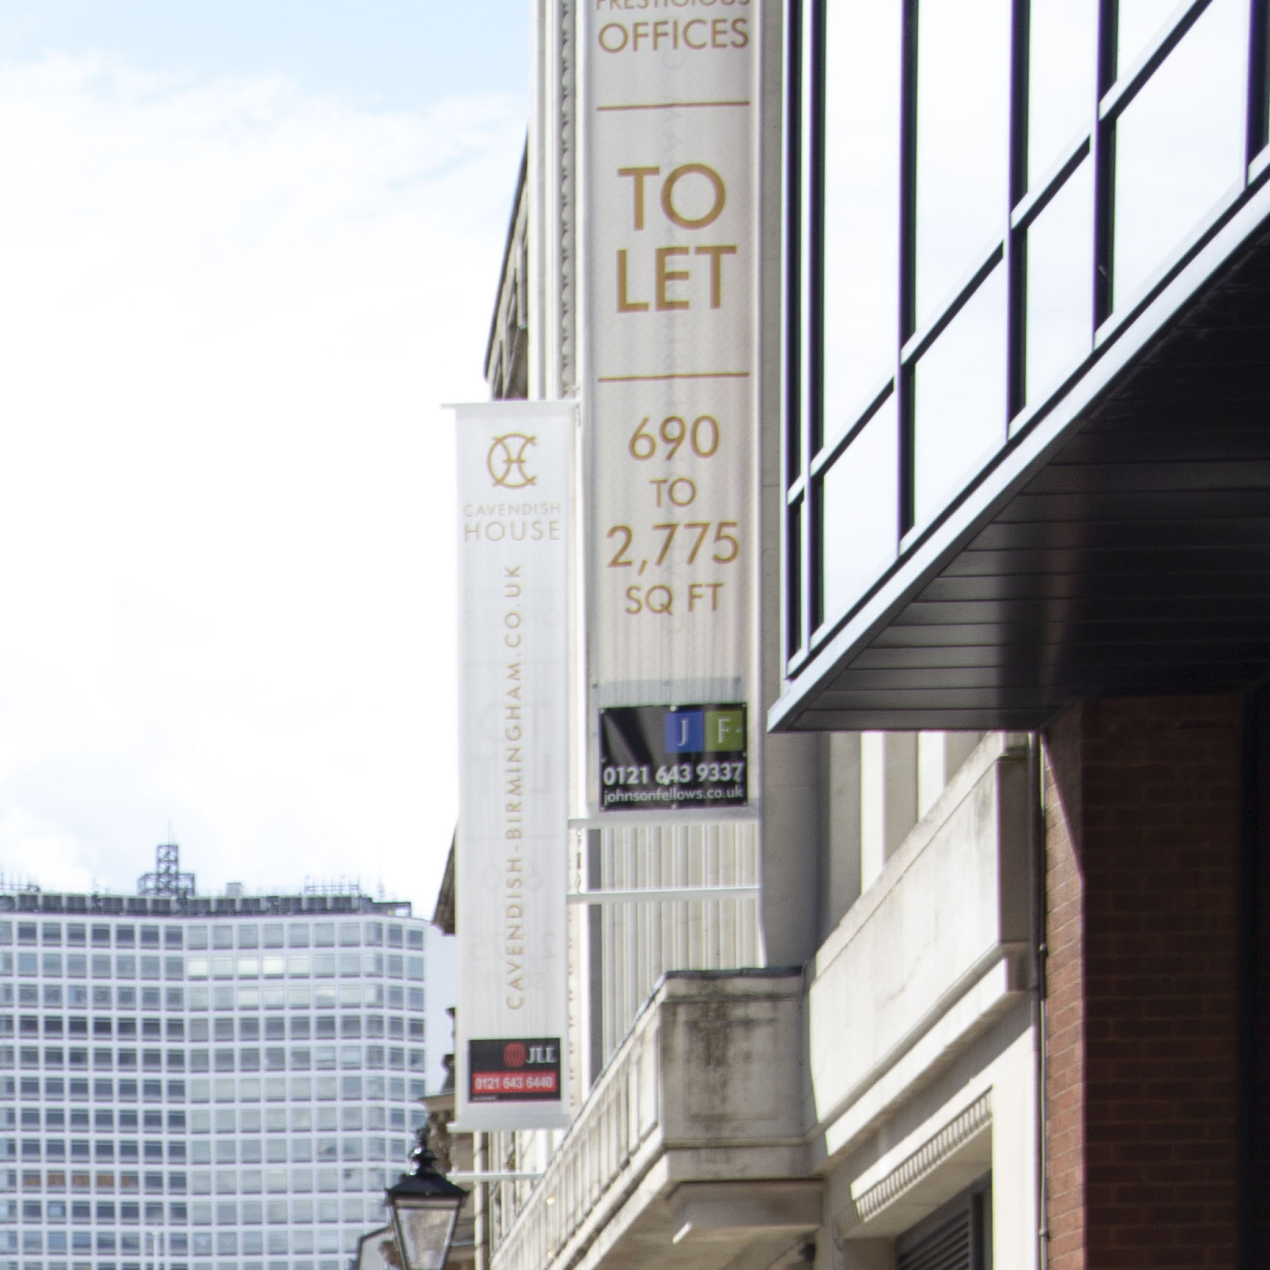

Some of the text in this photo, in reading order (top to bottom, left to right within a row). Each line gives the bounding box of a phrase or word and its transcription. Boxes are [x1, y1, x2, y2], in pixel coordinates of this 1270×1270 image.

[598, 18, 749, 53] OFFICES
[617, 163, 727, 231] TO
[616, 245, 738, 313] LET
[629, 415, 721, 461] 690
[649, 477, 697, 507] TO
[463, 502, 561, 518] CAVENDISH
[463, 520, 561, 542] HOUSE
[606, 521, 740, 575] 2,775
[625, 582, 724, 615] SQ FT
[677, 718, 689, 746] J
[505, 565, 526, 1011] CAVENDISH-BIRMINGHAM.CO.UK
[603, 762, 745, 785] 0121 643 9337
[603, 784, 744, 806] johnsonfellows.co.uk
[474, 1075, 553, 1090] 0121 643 6440
